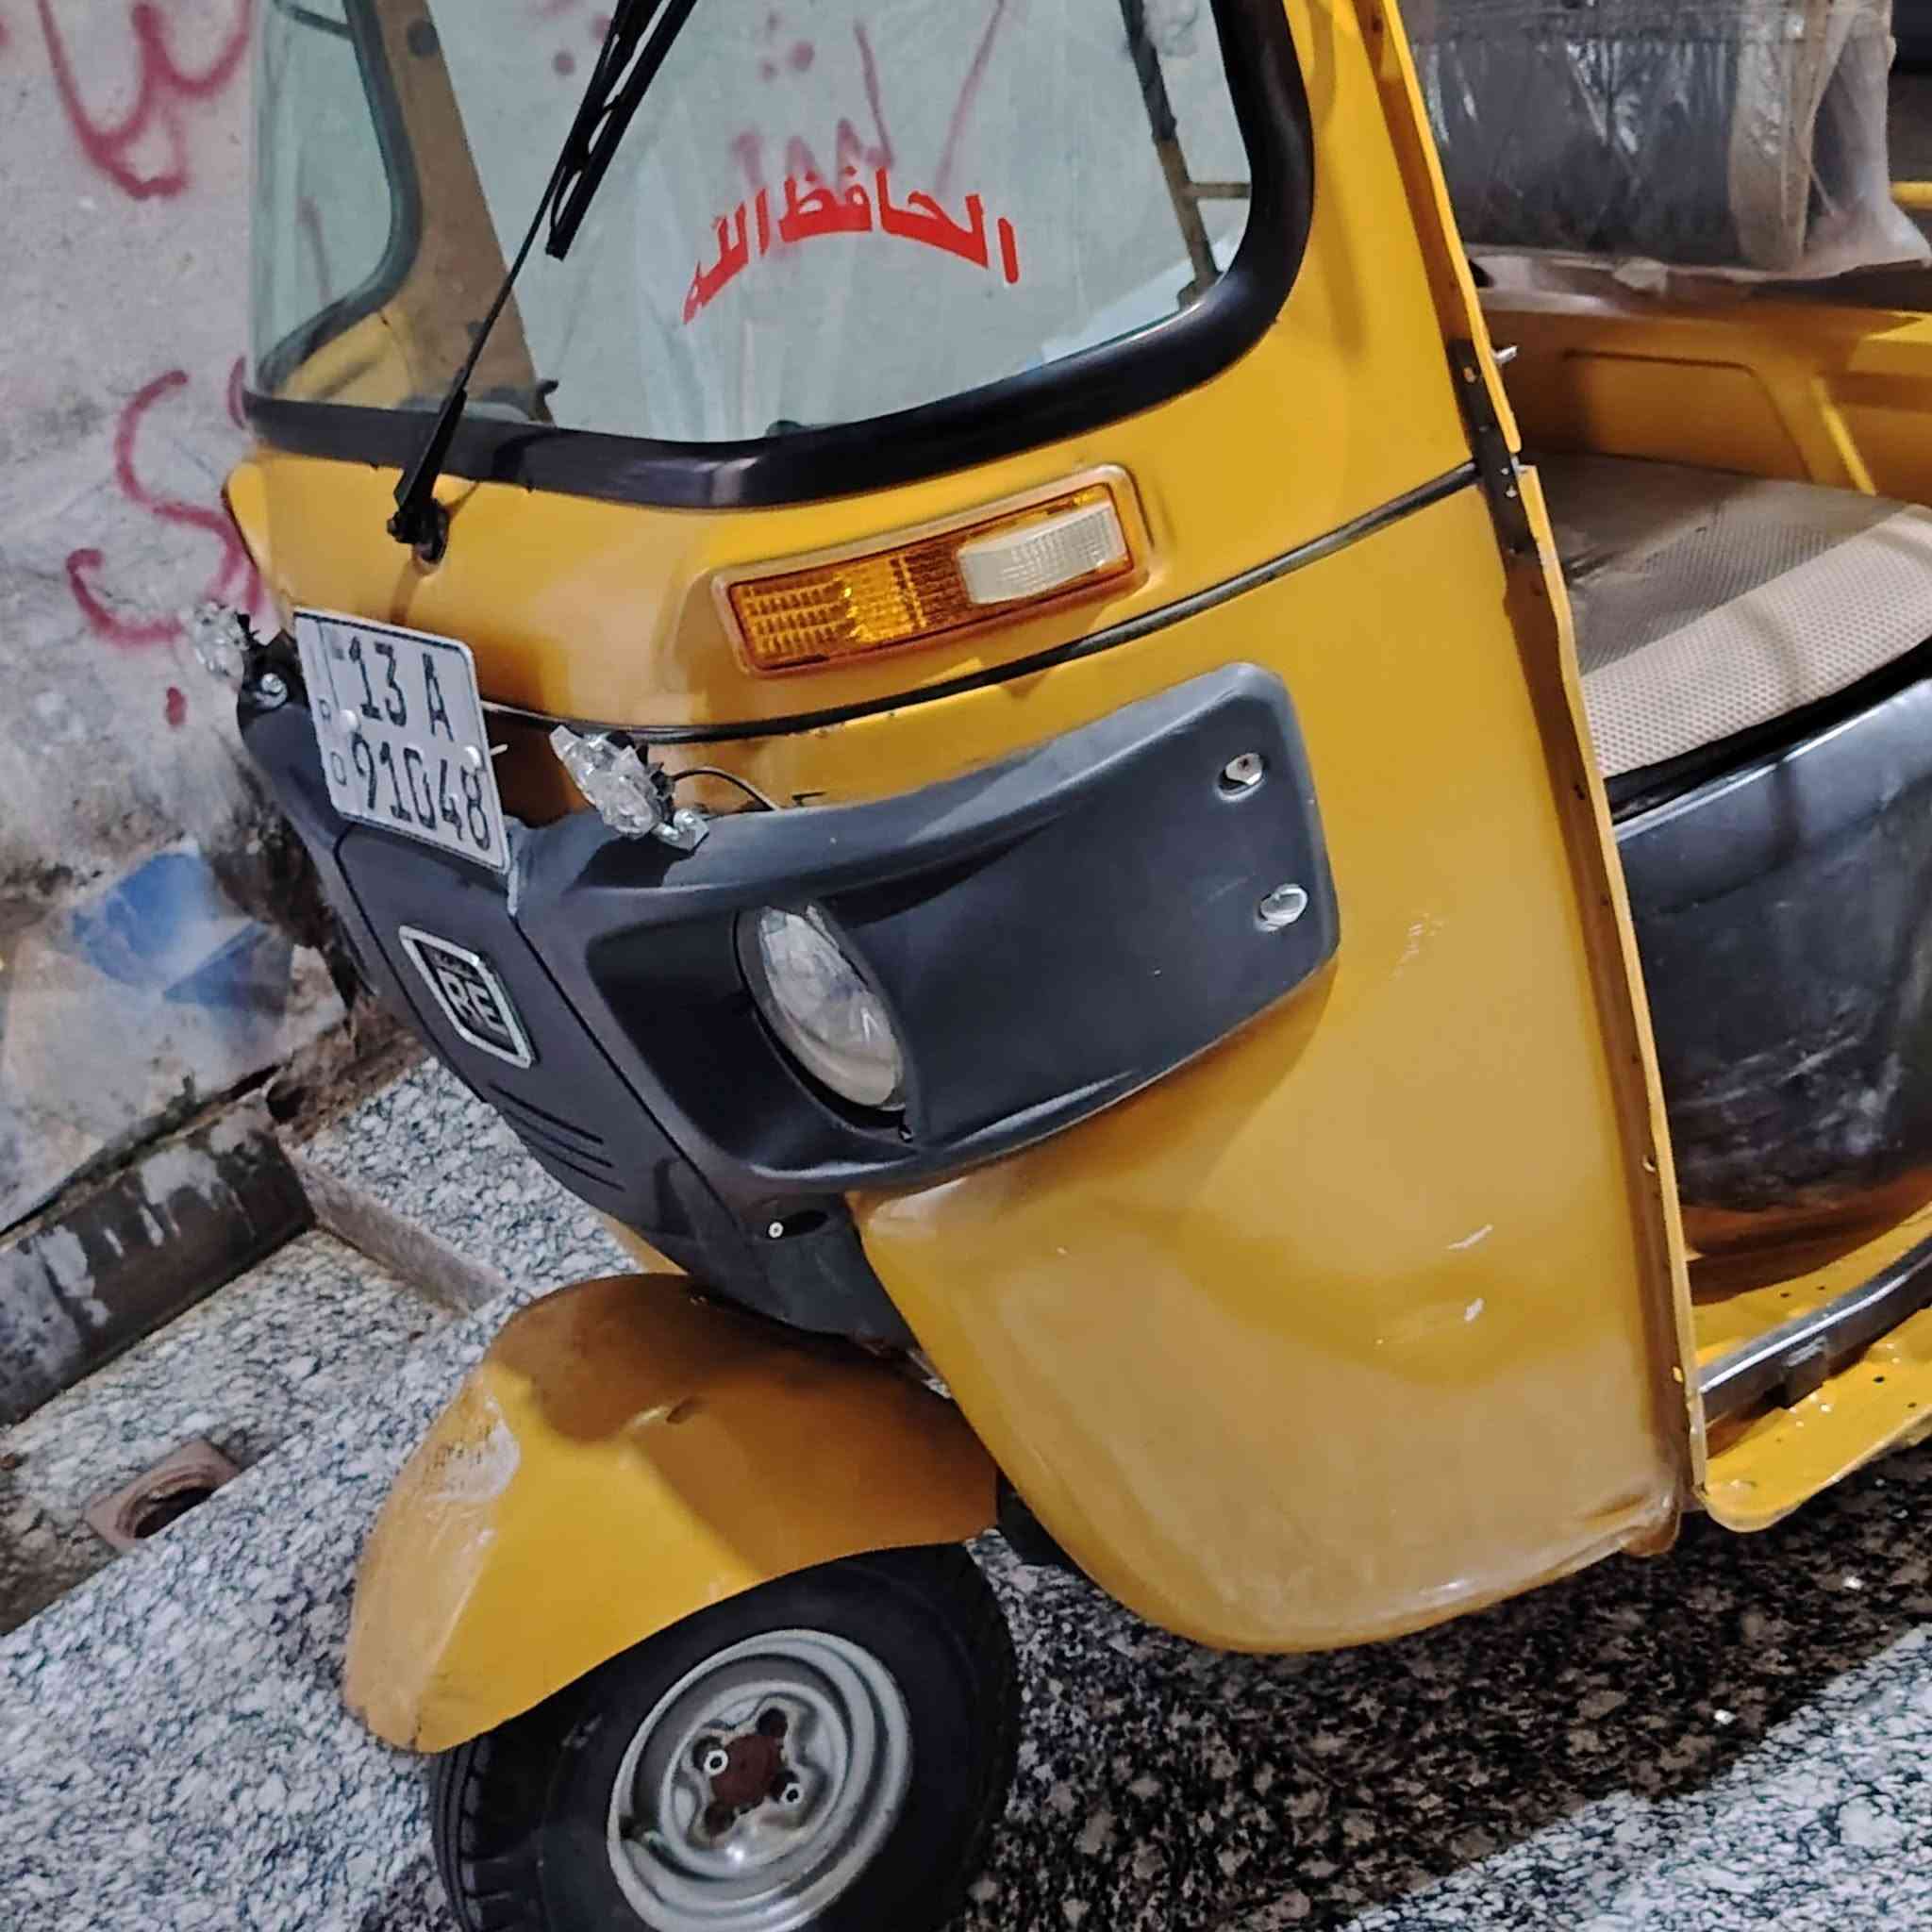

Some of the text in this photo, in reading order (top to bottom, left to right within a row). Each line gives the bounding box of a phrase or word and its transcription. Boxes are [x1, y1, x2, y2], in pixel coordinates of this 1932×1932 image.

[682, 166, 1019, 325] الحافظ الله
[349, 636, 455, 741] 13 A
[352, 731, 490, 850] 91048
[435, 967, 508, 1036] RE
